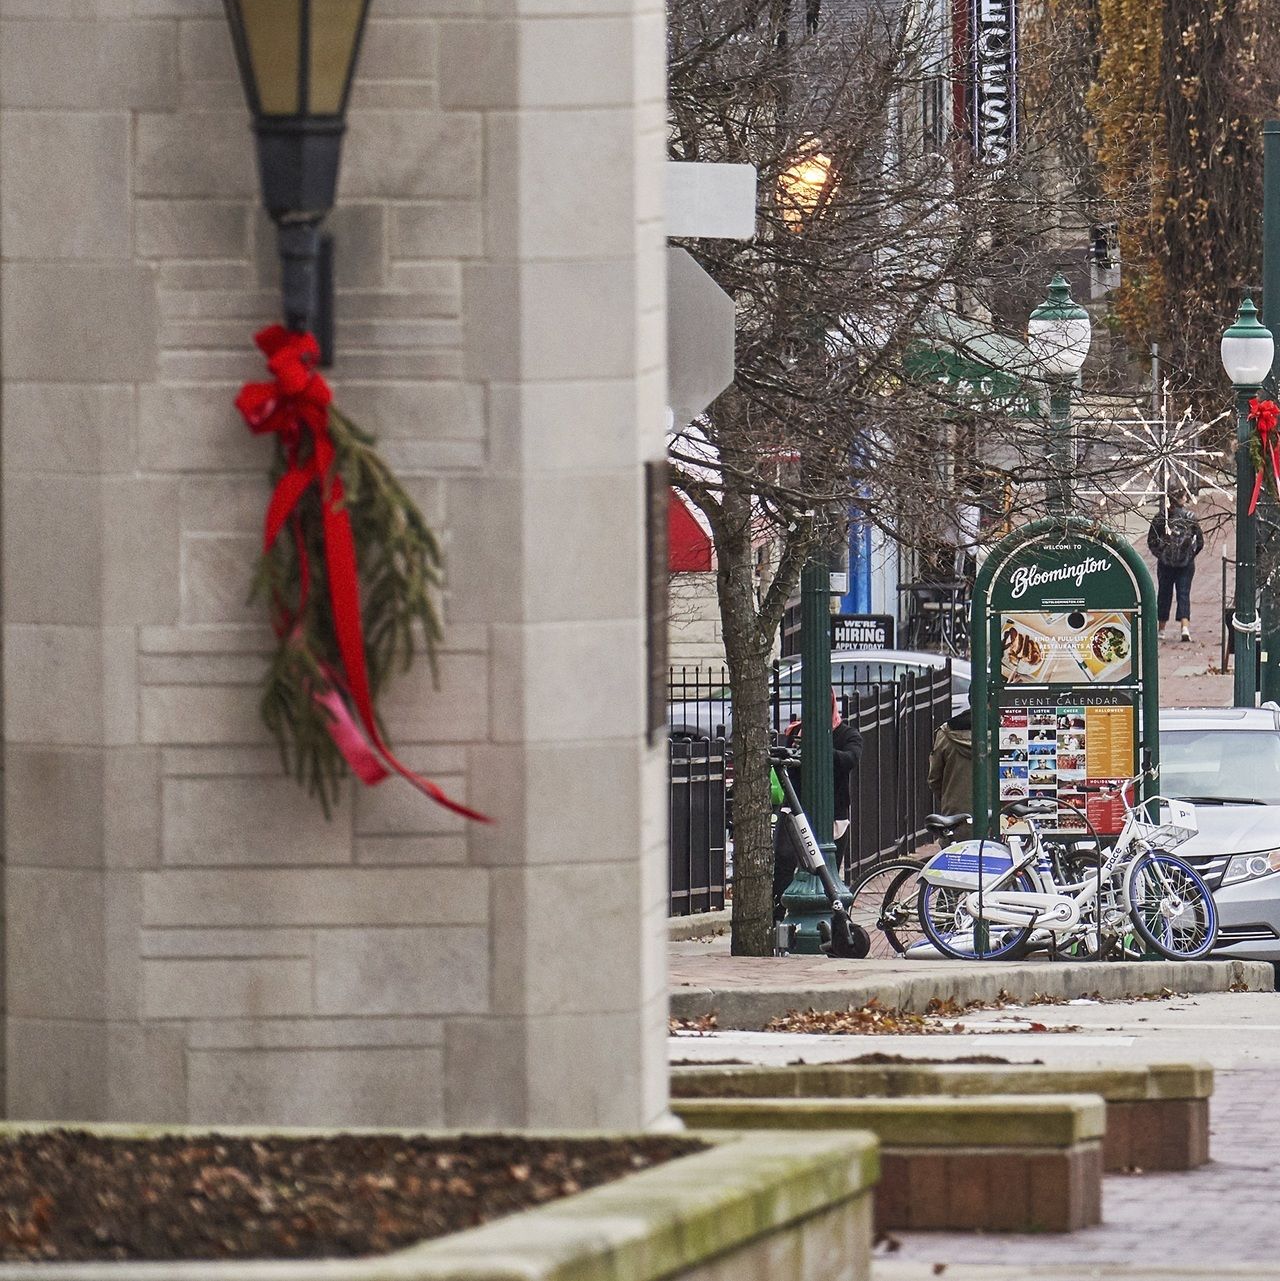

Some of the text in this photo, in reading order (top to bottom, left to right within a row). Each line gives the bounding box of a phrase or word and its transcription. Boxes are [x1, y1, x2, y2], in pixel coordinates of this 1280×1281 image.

[1009, 556, 1112, 599] Bloomington
[843, 620, 877, 628] WE'RE
[835, 627, 885, 643] HIRING
[1014, 697, 1118, 706] EVENT CALENDAR
[800, 827, 816, 856] BIRD
[1105, 847, 1122, 871] pace
